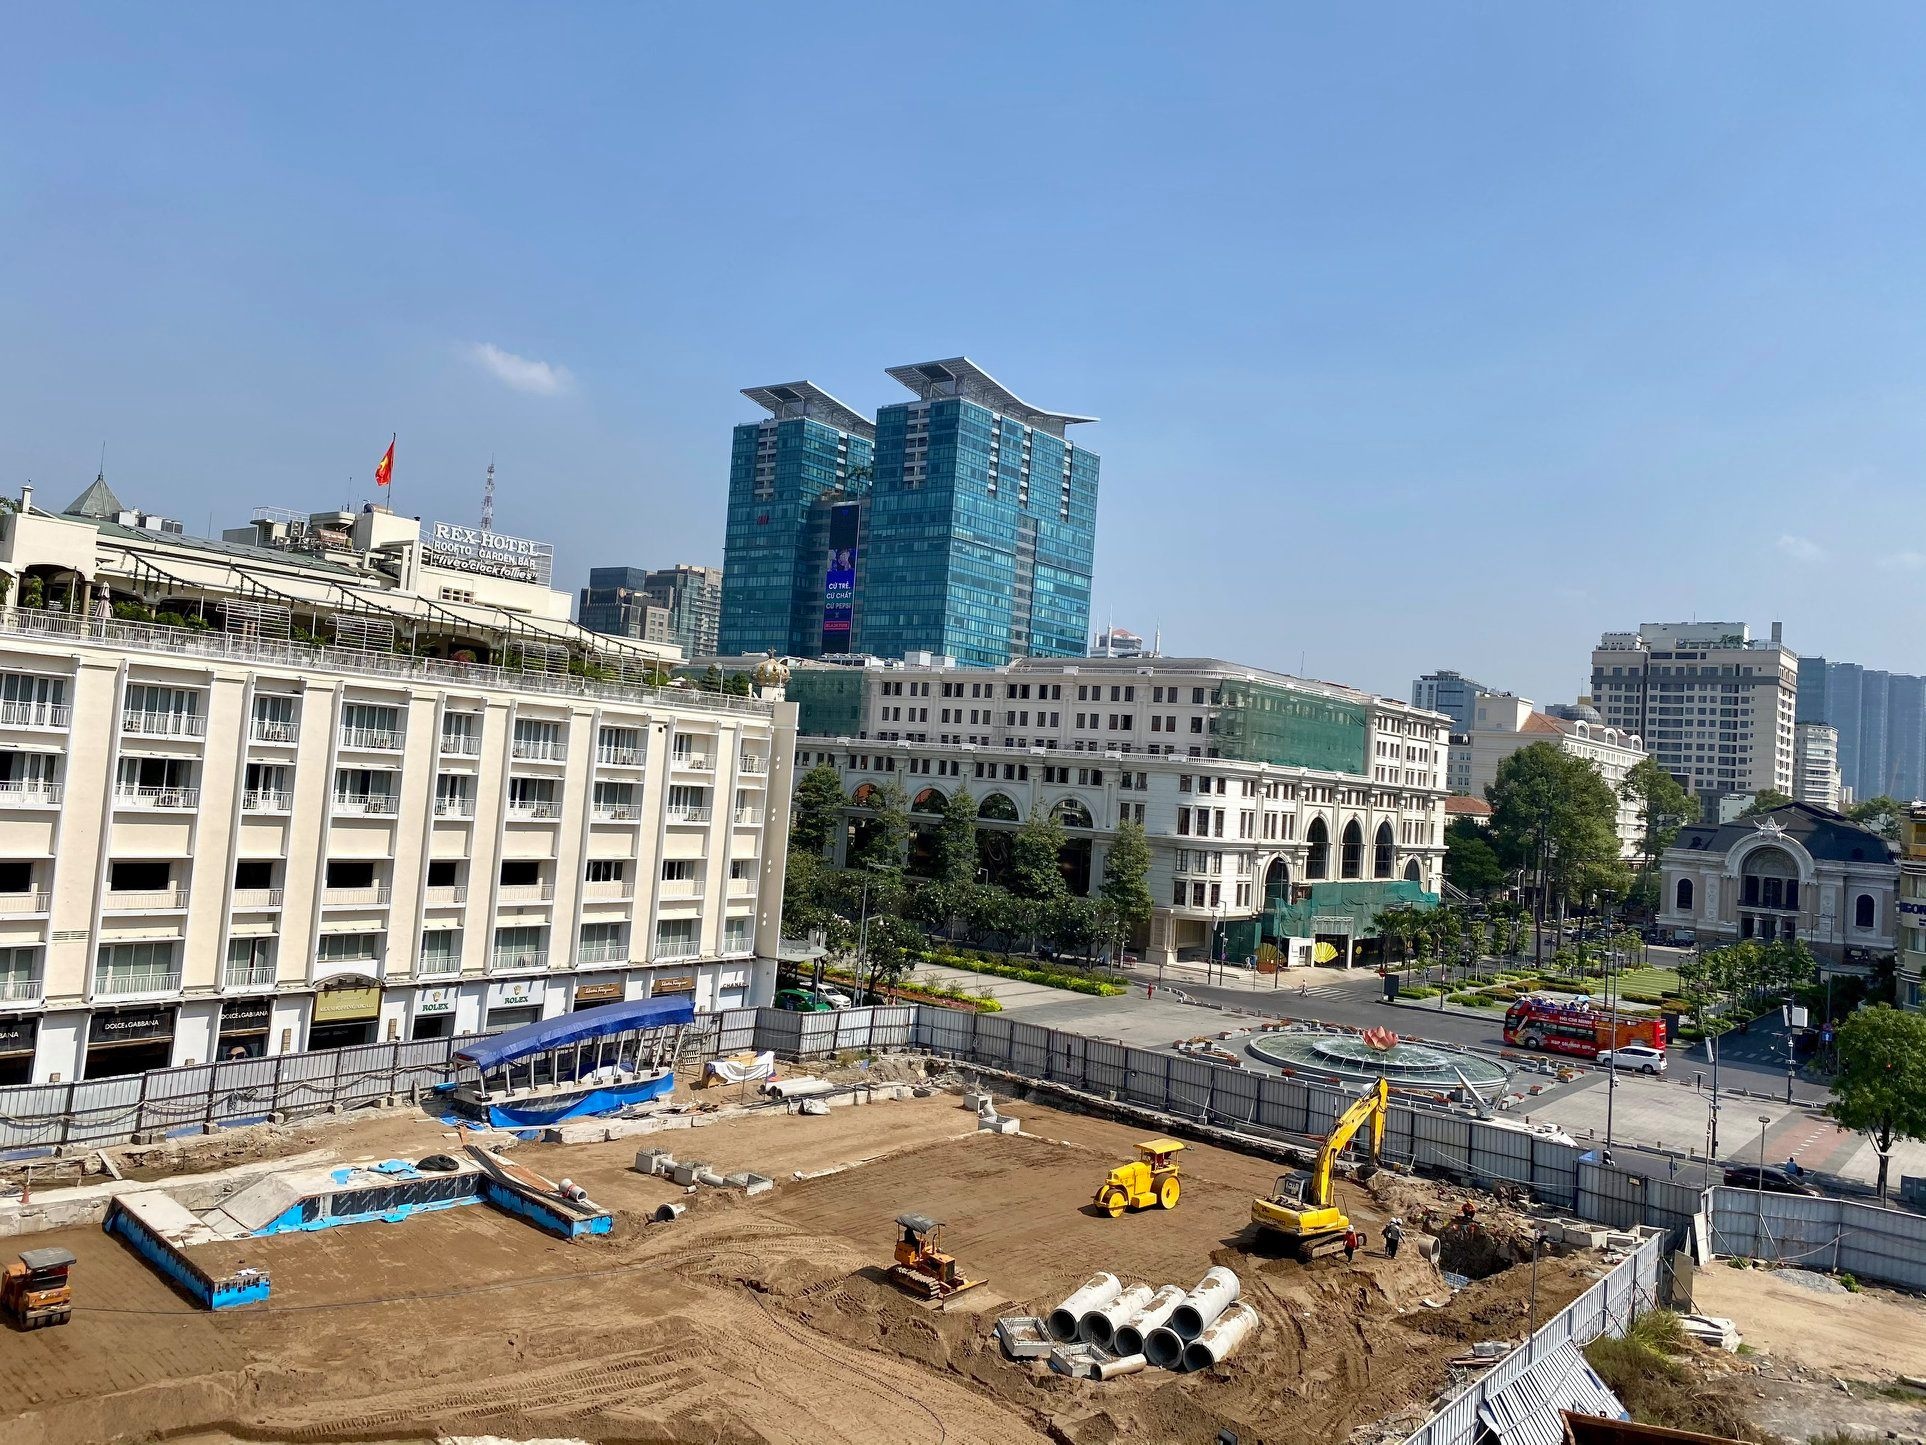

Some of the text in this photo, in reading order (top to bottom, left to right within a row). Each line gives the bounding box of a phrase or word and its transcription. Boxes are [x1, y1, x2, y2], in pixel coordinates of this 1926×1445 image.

[436, 523, 538, 556] REX HOTEL
[479, 549, 517, 566] GARDEN
[518, 556, 536, 570] BAR
[422, 1003, 449, 1012] ROLEX
[504, 996, 528, 1004] ROLEX
